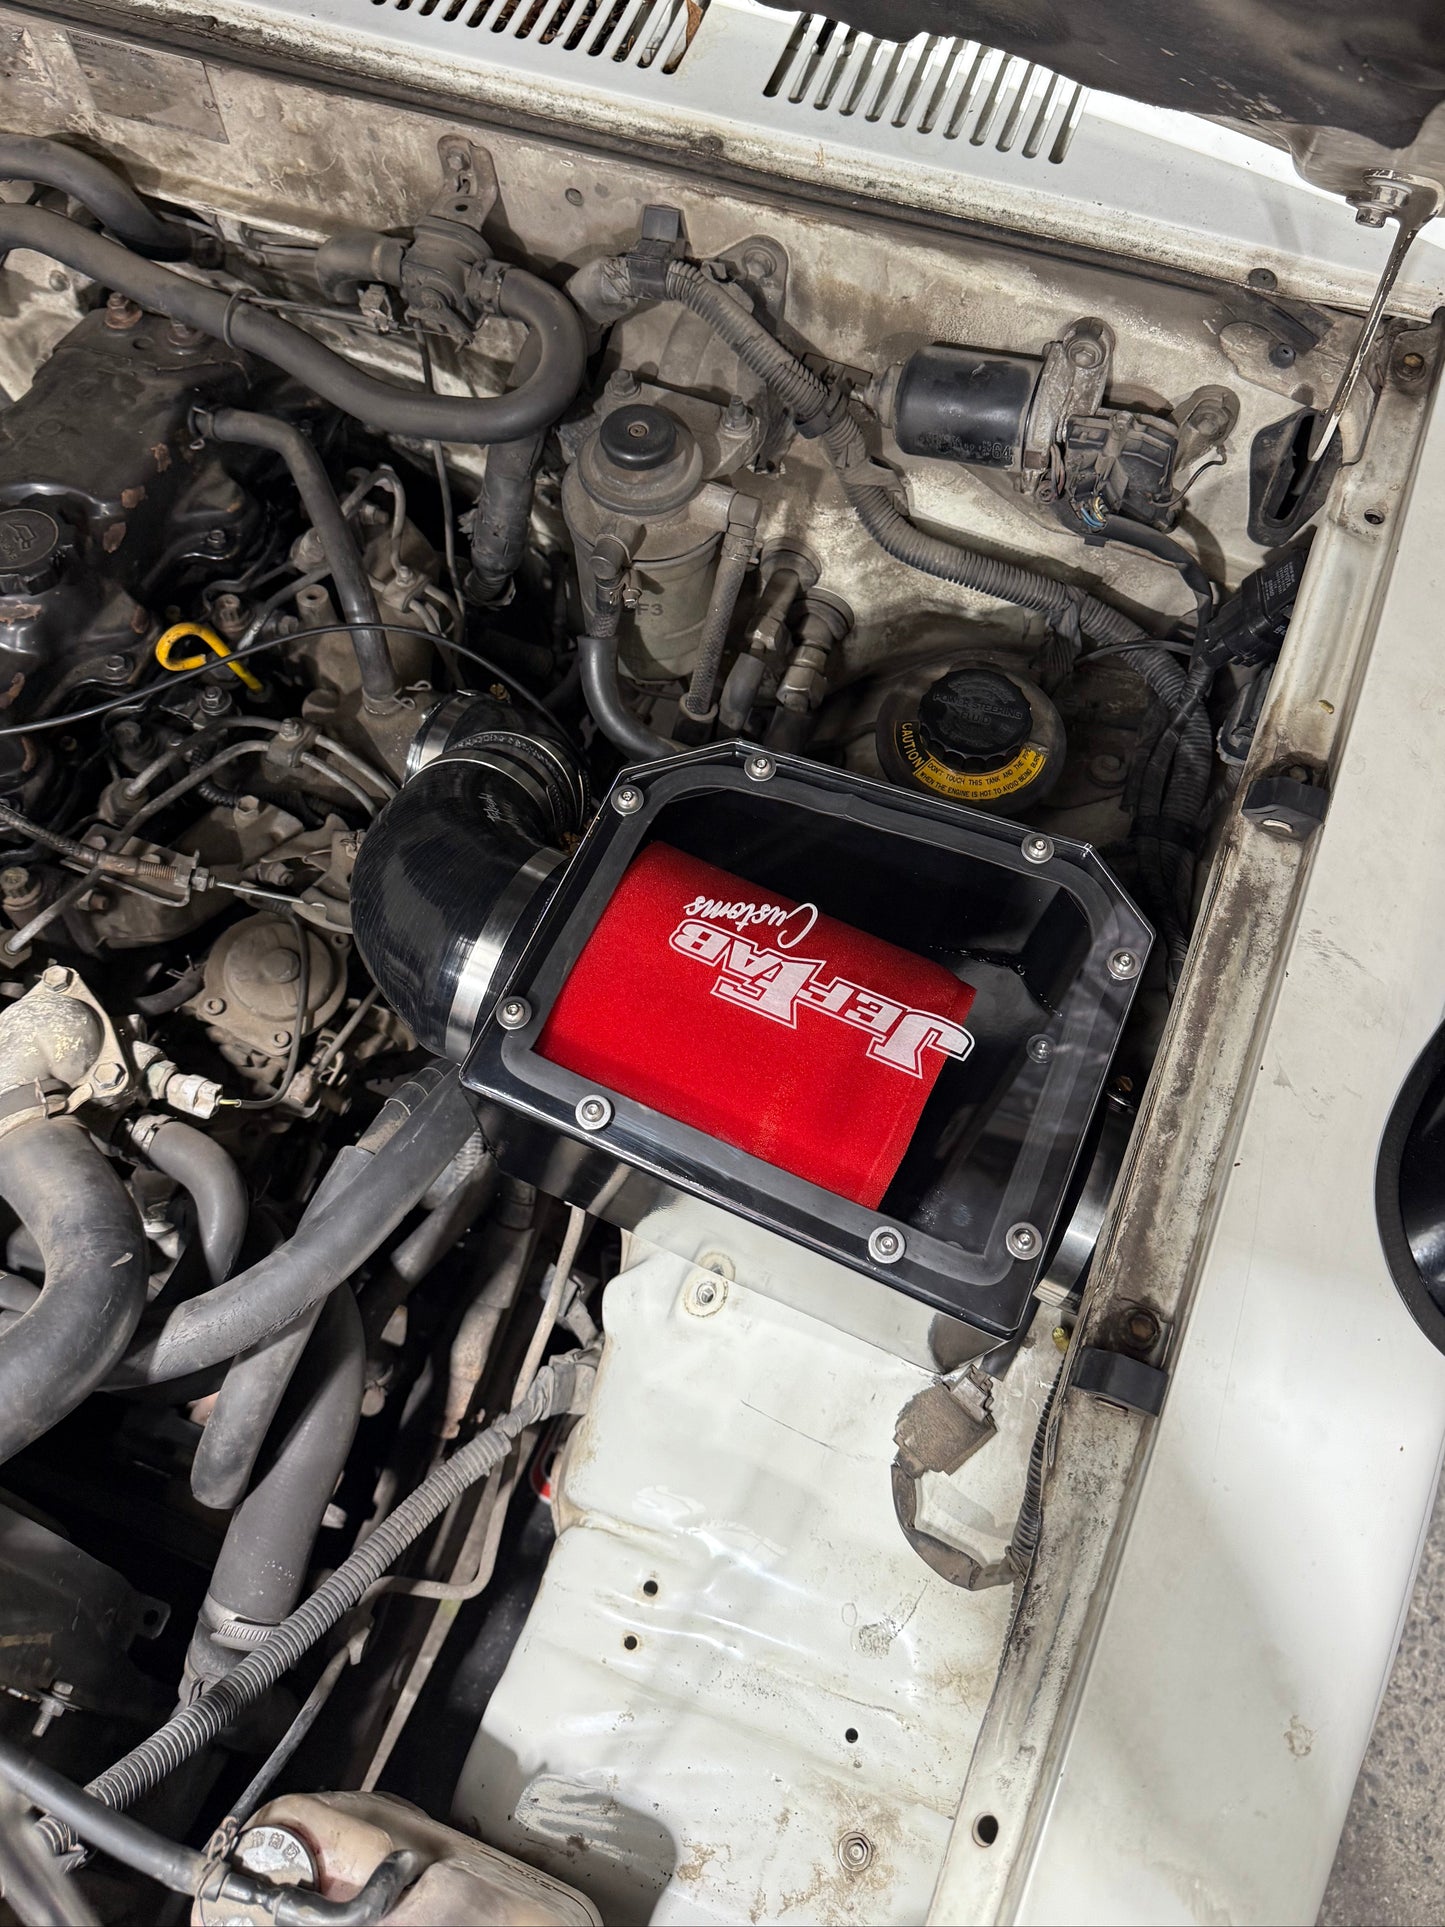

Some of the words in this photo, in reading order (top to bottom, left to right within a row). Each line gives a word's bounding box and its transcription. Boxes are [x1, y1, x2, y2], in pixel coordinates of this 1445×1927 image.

[960, 711, 991, 726] FLUID
[971, 701, 1023, 720] STEERING
[901, 722, 926, 769] CAUTION
[919, 771, 934, 786] WHEN
[935, 782, 947, 793] THE
[947, 787, 970, 798] ENGINE
[971, 790, 978, 798] IS
[979, 789, 992, 798] HOT
[993, 787, 1002, 796] TO
[1002, 781, 1019, 793] AVOID
[1018, 769, 1033, 784] BEING
[927, 760, 944, 777] DON'T
[945, 773, 965, 786] TOUCH
[968, 777, 983, 786] THIS
[986, 776, 1001, 786] TANK
[1002, 769, 1014, 780] AND
[1013, 760, 1024, 771] THE
[682, 895, 819, 949] Customs
